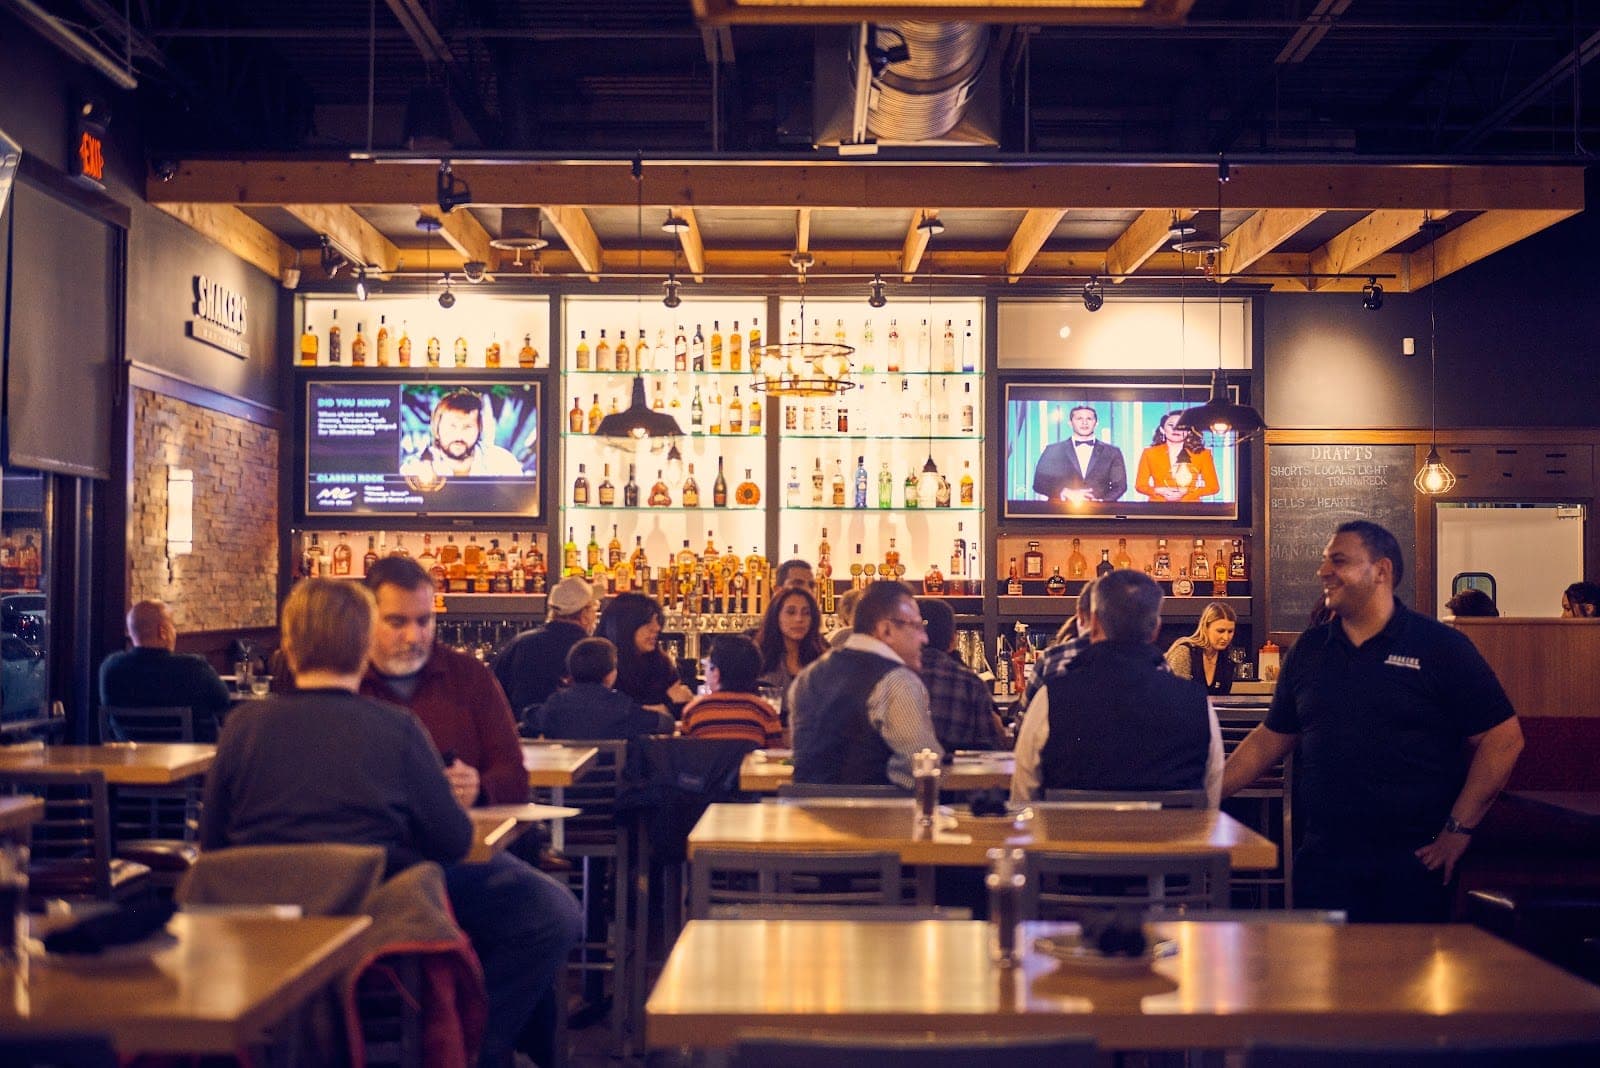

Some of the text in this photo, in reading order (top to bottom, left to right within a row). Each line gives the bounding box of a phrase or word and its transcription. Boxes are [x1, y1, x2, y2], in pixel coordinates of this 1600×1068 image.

[83, 131, 103, 179] EXIT
[198, 274, 248, 335] SHAKERS
[317, 398, 391, 408] DID YOU KNOW?
[1311, 445, 1373, 461] DRAFTS
[1270, 465, 1388, 477] SHORTS LOCALS LIGHT
[316, 474, 385, 483] CLASSIC ROCK
[1271, 497, 1305, 508] BELLS
